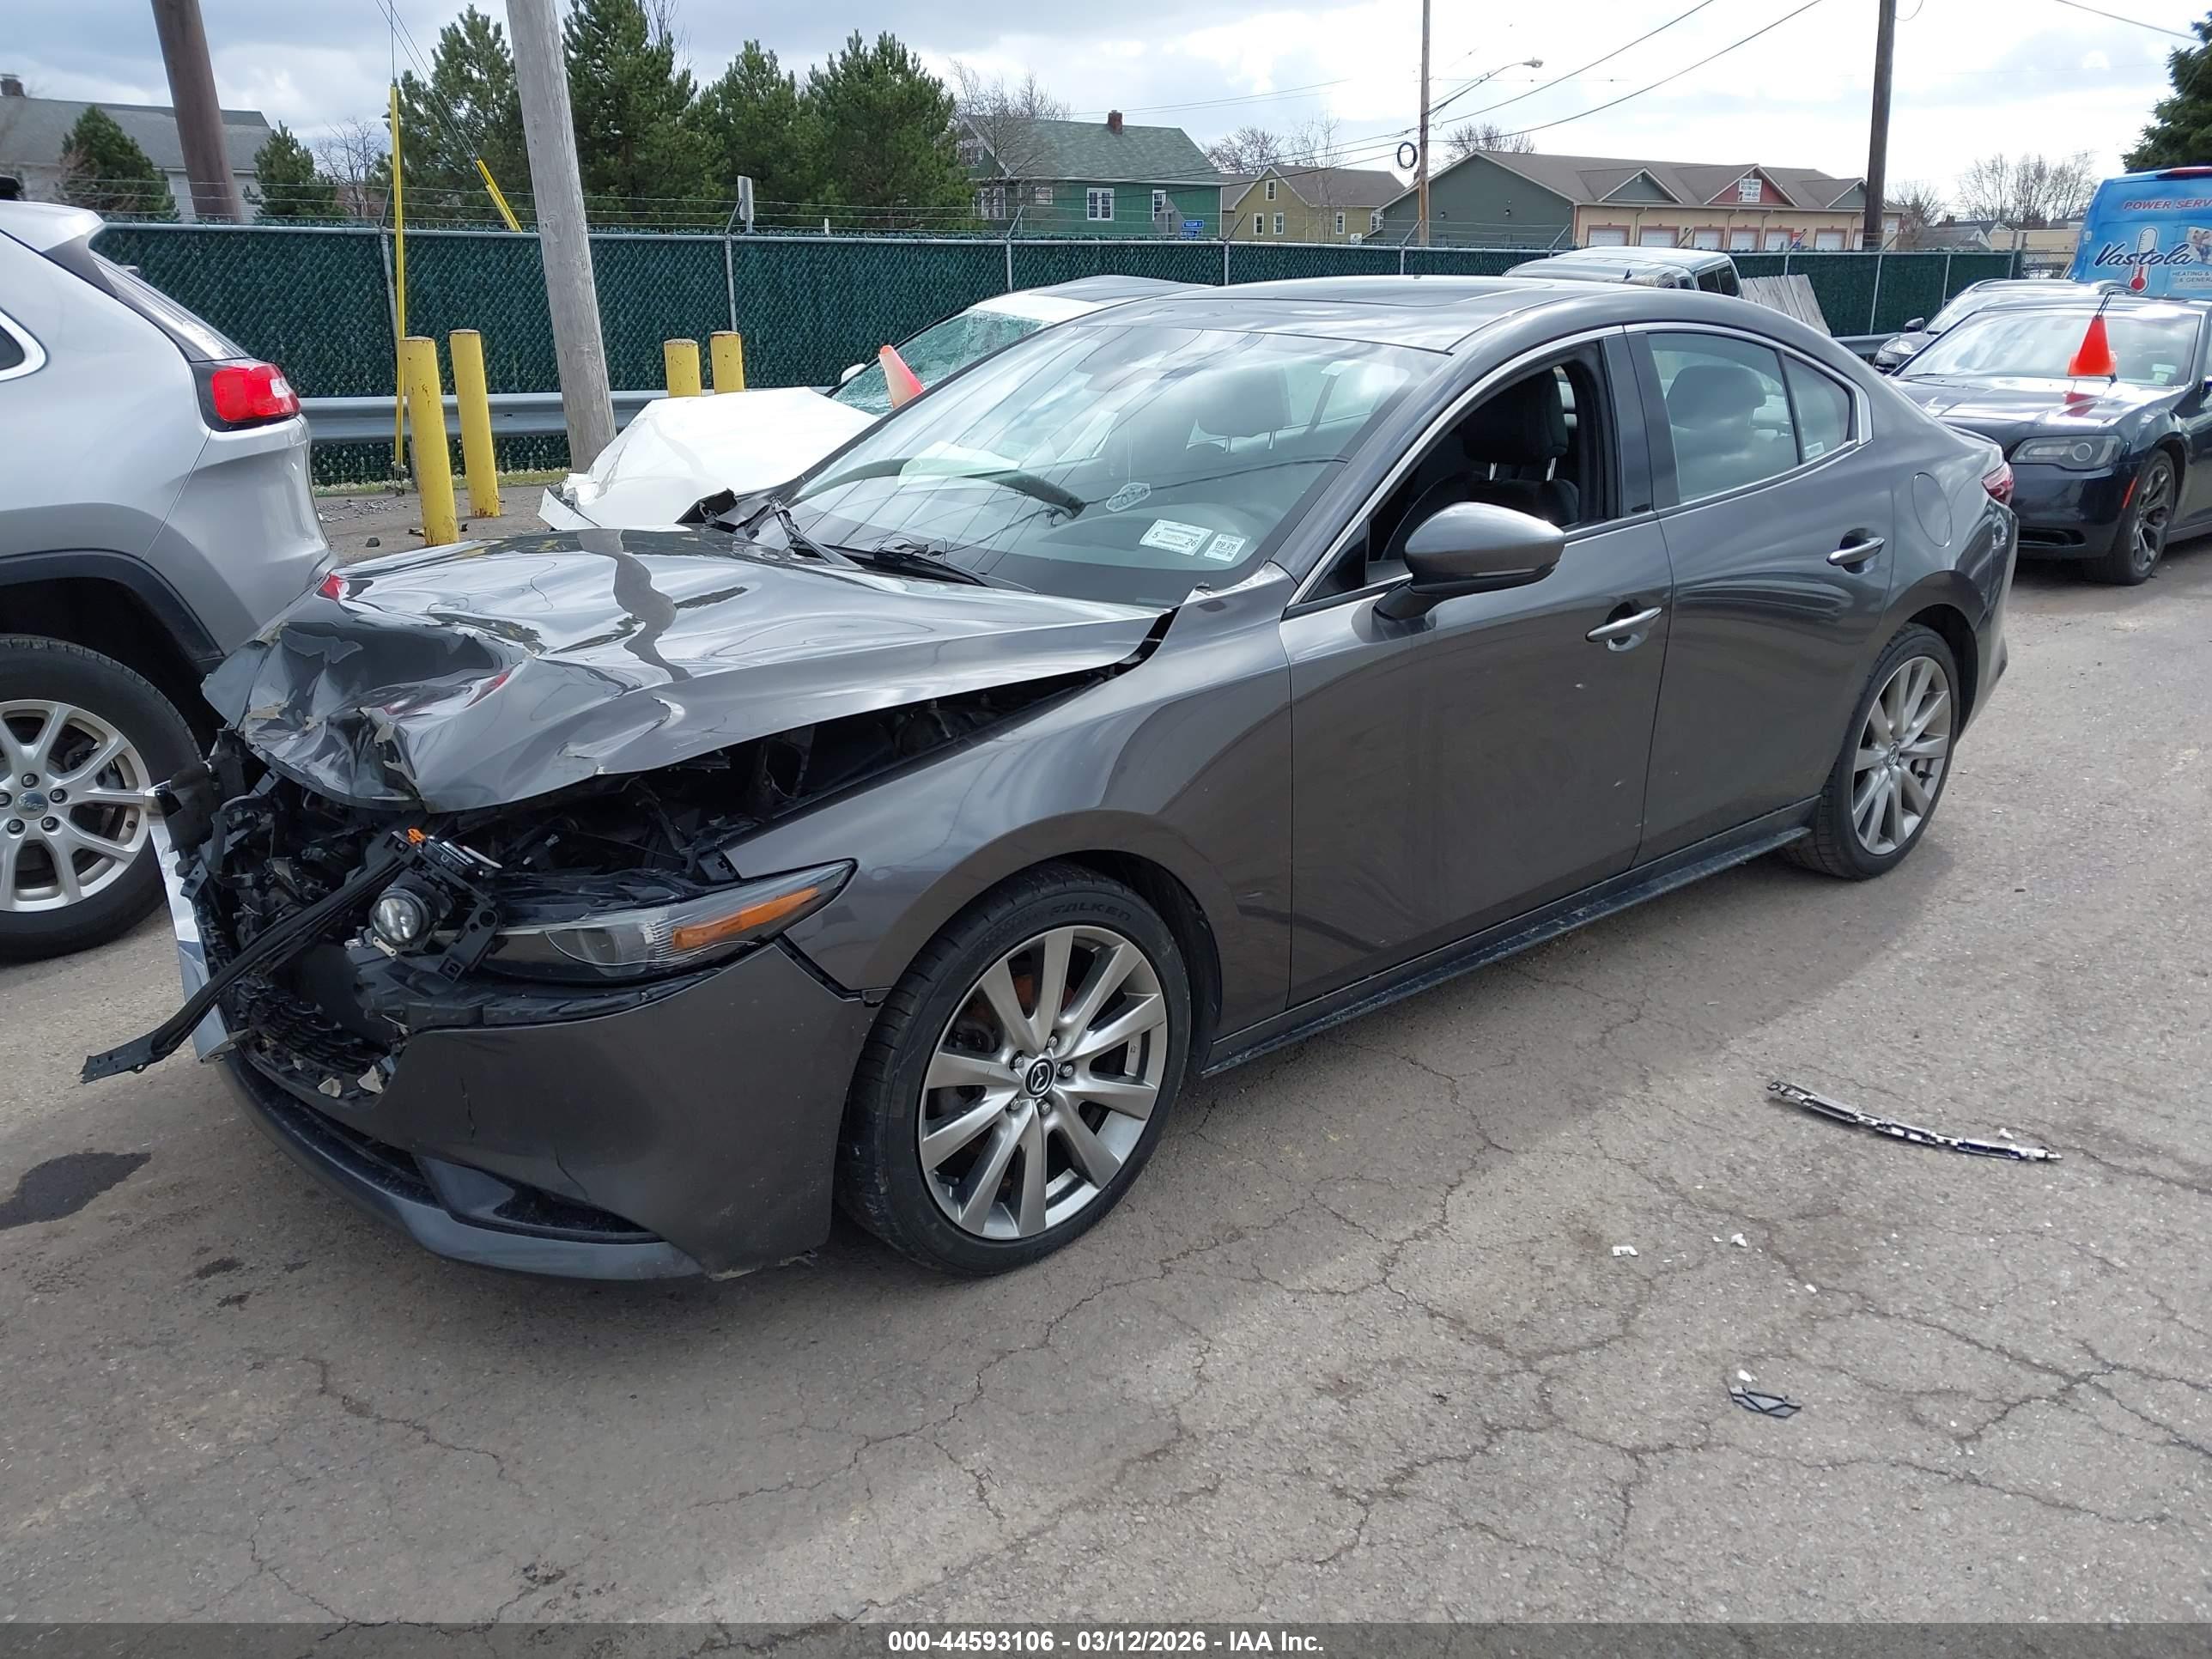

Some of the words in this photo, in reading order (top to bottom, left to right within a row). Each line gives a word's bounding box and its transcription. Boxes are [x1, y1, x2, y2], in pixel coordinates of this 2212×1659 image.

[2124, 200, 2172, 210] POWER
[2094, 242, 2194, 266] Vastola
[1185, 538, 1199, 547] 26
